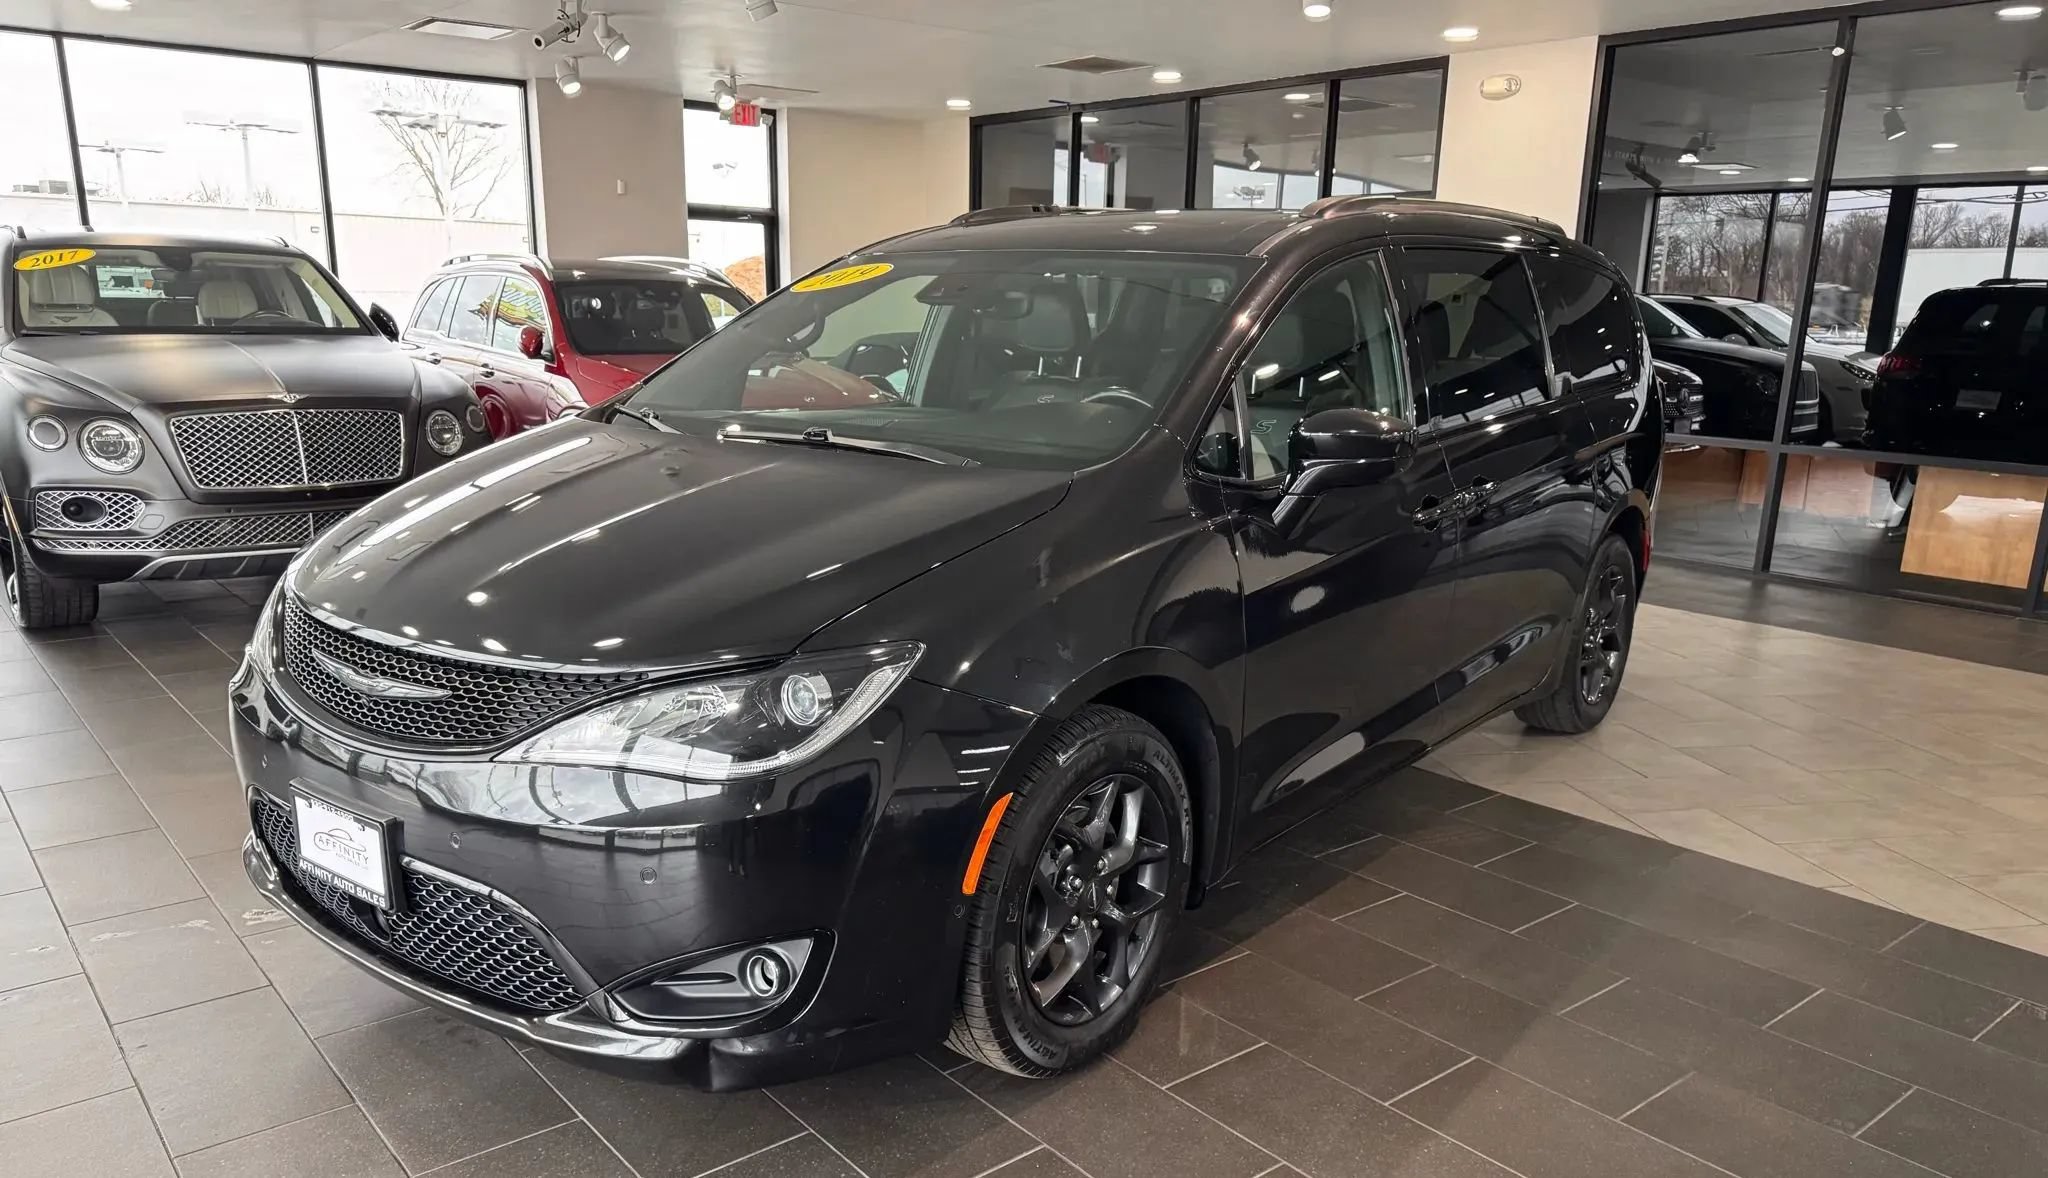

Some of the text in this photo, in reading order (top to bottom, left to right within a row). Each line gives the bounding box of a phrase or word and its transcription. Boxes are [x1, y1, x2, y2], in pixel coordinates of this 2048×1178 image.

[735, 103, 758, 125] EXIT
[31, 249, 79, 268] 2017
[1153, 750, 1186, 800] ALTIMAX
[318, 835, 369, 865] AFFINITY
[299, 859, 386, 909] AFFINITY AUTO SALES
